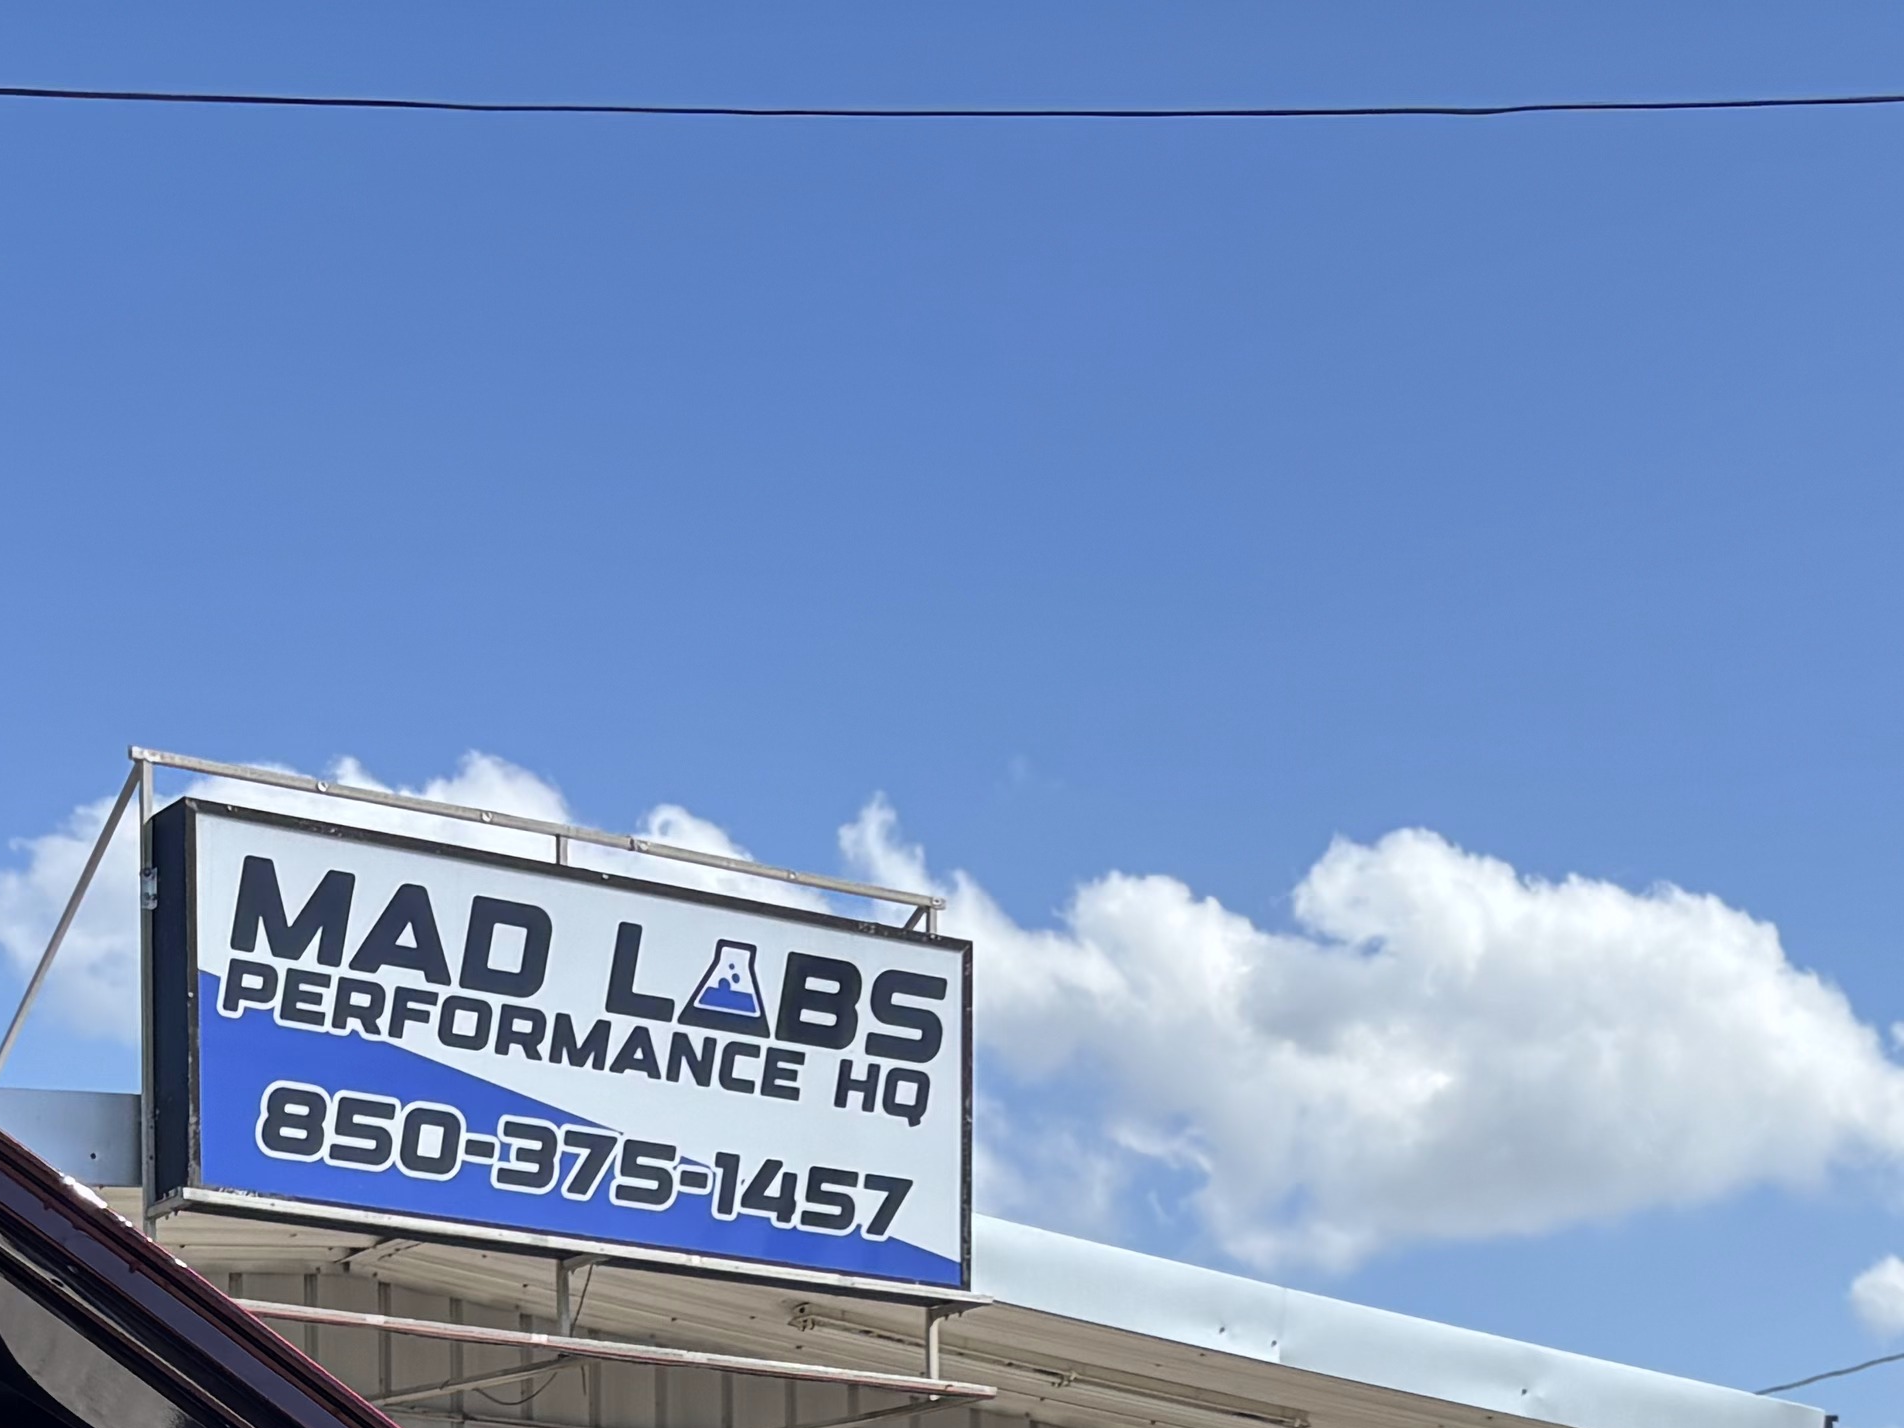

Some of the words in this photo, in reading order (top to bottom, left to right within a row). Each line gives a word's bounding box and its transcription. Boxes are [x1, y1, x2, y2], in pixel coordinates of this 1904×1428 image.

[223, 959, 807, 1103] PERFORMANCE
[834, 1058, 932, 1128] HQ
[229, 855, 553, 999] MAD
[606, 921, 948, 1064] LABS
[260, 1088, 915, 1239] 850-375-1457
